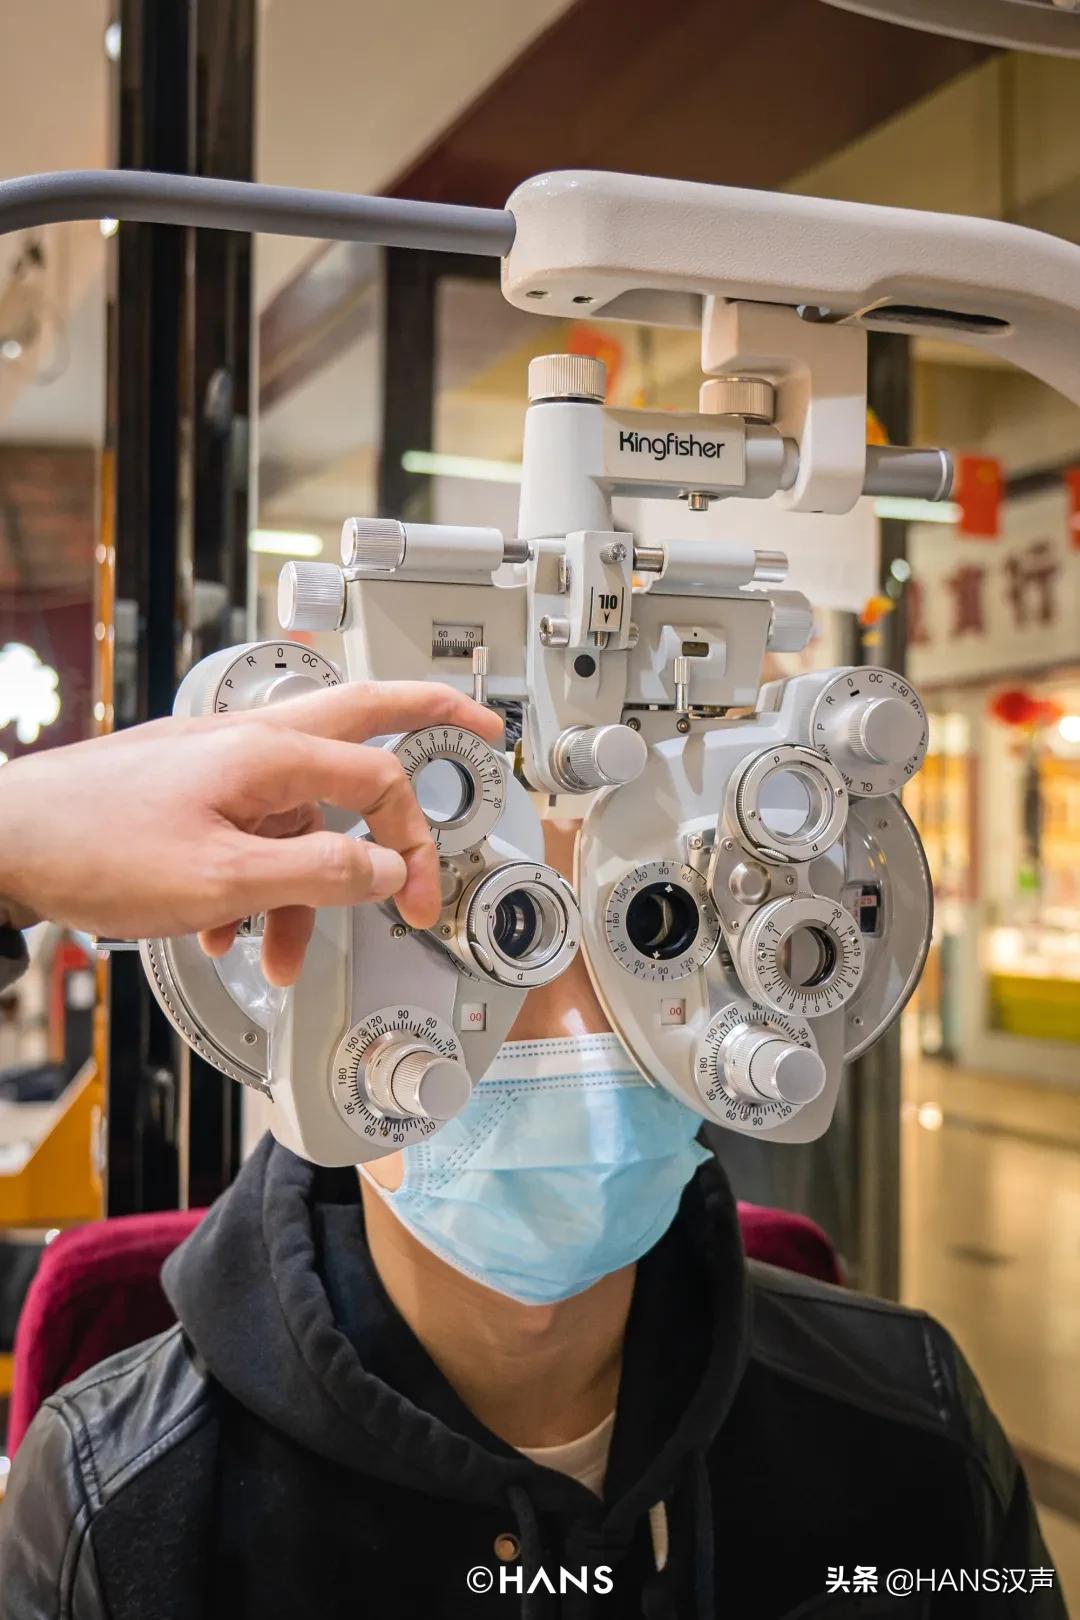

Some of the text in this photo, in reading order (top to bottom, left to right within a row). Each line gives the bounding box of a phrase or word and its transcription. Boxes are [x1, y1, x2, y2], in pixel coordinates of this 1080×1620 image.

[619, 431, 725, 460] Kingfisher
[438, 630, 448, 638] 60
[246, 656, 257, 667] R
[301, 653, 318, 668] OC
[225, 679, 234, 689] P
[868, 673, 884, 684] OC
[825, 695, 836, 705] R
[816, 723, 825, 731] P
[428, 732, 435, 741] 3
[443, 730, 449, 739] 6
[458, 732, 464, 741] 9
[415, 739, 422, 747] 0
[470, 739, 481, 750] 12
[404, 748, 412, 756] 3
[484, 752, 494, 763] 15
[493, 797, 502, 808] 20
[658, 867, 670, 875] 90
[633, 871, 648, 883] 120
[681, 872, 693, 883] 60
[617, 888, 629, 903] 150
[699, 891, 709, 902] 30
[832, 908, 842, 919] 20
[612, 912, 620, 929] 180
[764, 921, 775, 932] 20
[847, 925, 856, 935] 18
[617, 942, 628, 953] 30
[698, 937, 710, 952] 150
[758, 942, 766, 952] 18
[854, 947, 861, 957] 15
[634, 960, 645, 970] 60
[680, 957, 695, 969] 120
[657, 967, 669, 975] 90
[757, 965, 765, 975] 15
[852, 966, 860, 975] 12
[764, 982, 774, 992] 12
[397, 1009, 409, 1019] 90
[469, 1012, 482, 1022] 00
[669, 1007, 682, 1016] 00
[723, 1007, 739, 1022] 120
[366, 1015, 383, 1030] 120
[425, 1016, 438, 1029] 60
[704, 1028, 718, 1045] 150
[798, 1027, 809, 1040] 30
[344, 1036, 359, 1054] 150
[445, 1038, 457, 1051] 30
[699, 1057, 708, 1074] 180
[338, 1067, 347, 1085] 180
[705, 1088, 716, 1101] 30
[343, 1102, 355, 1115] 30
[777, 1105, 792, 1119] 120
[725, 1110, 737, 1121] 60
[752, 1117, 764, 1126] 90
[364, 1124, 376, 1136] 60
[419, 1121, 436, 1136] 120
[392, 1133, 405, 1143] 90
